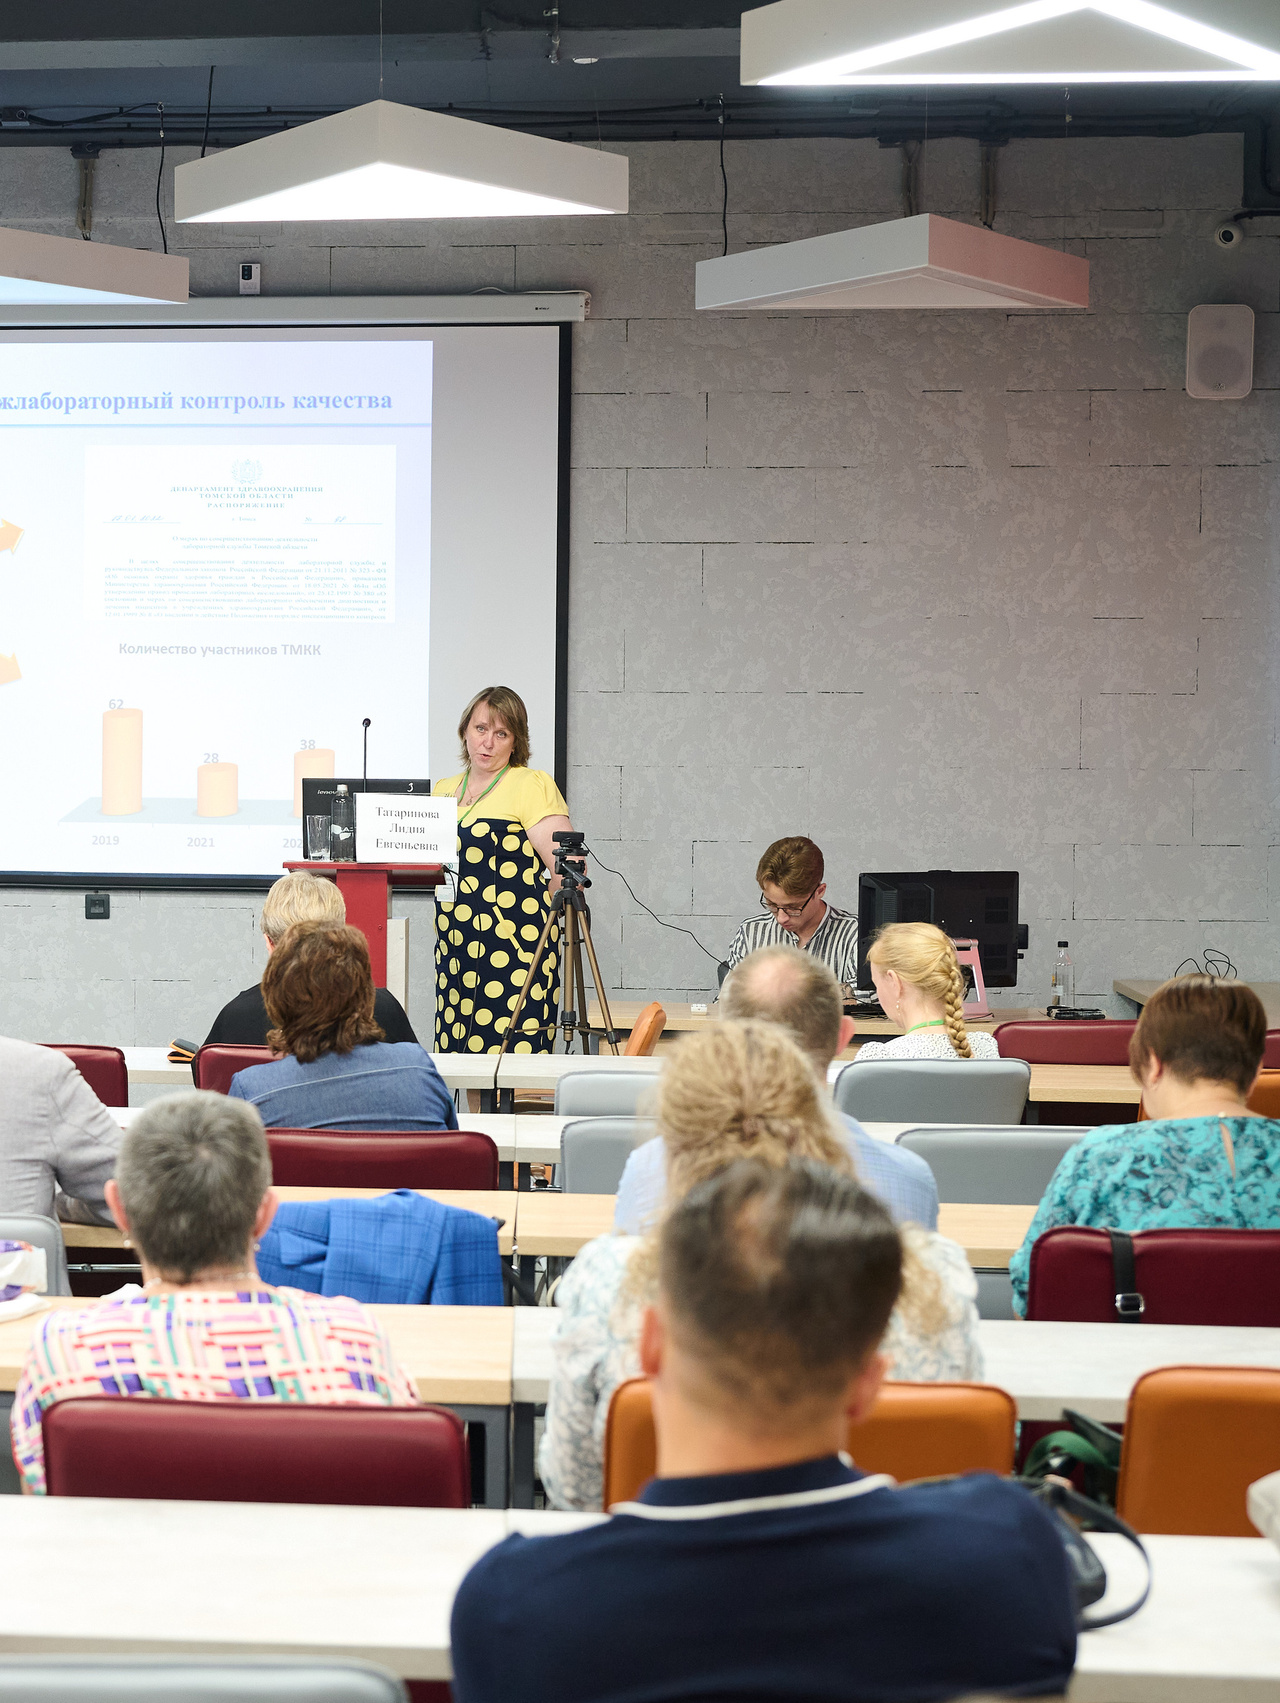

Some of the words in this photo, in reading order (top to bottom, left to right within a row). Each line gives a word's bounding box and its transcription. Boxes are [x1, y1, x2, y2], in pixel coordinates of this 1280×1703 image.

[180, 395, 286, 414] контроль
[292, 395, 393, 409] качества
[119, 643, 197, 656] Количество
[200, 644, 278, 658] участников
[281, 644, 322, 656] ТМКК
[108, 698, 125, 710] 62
[299, 739, 316, 750] 38
[203, 752, 219, 763] 28
[375, 806, 440, 820] Татаринова
[389, 823, 426, 835] Лидия
[91, 835, 120, 846] 2019
[186, 837, 216, 848] 2021
[282, 838, 302, 849] 202
[376, 838, 439, 851] Евгеньевна
